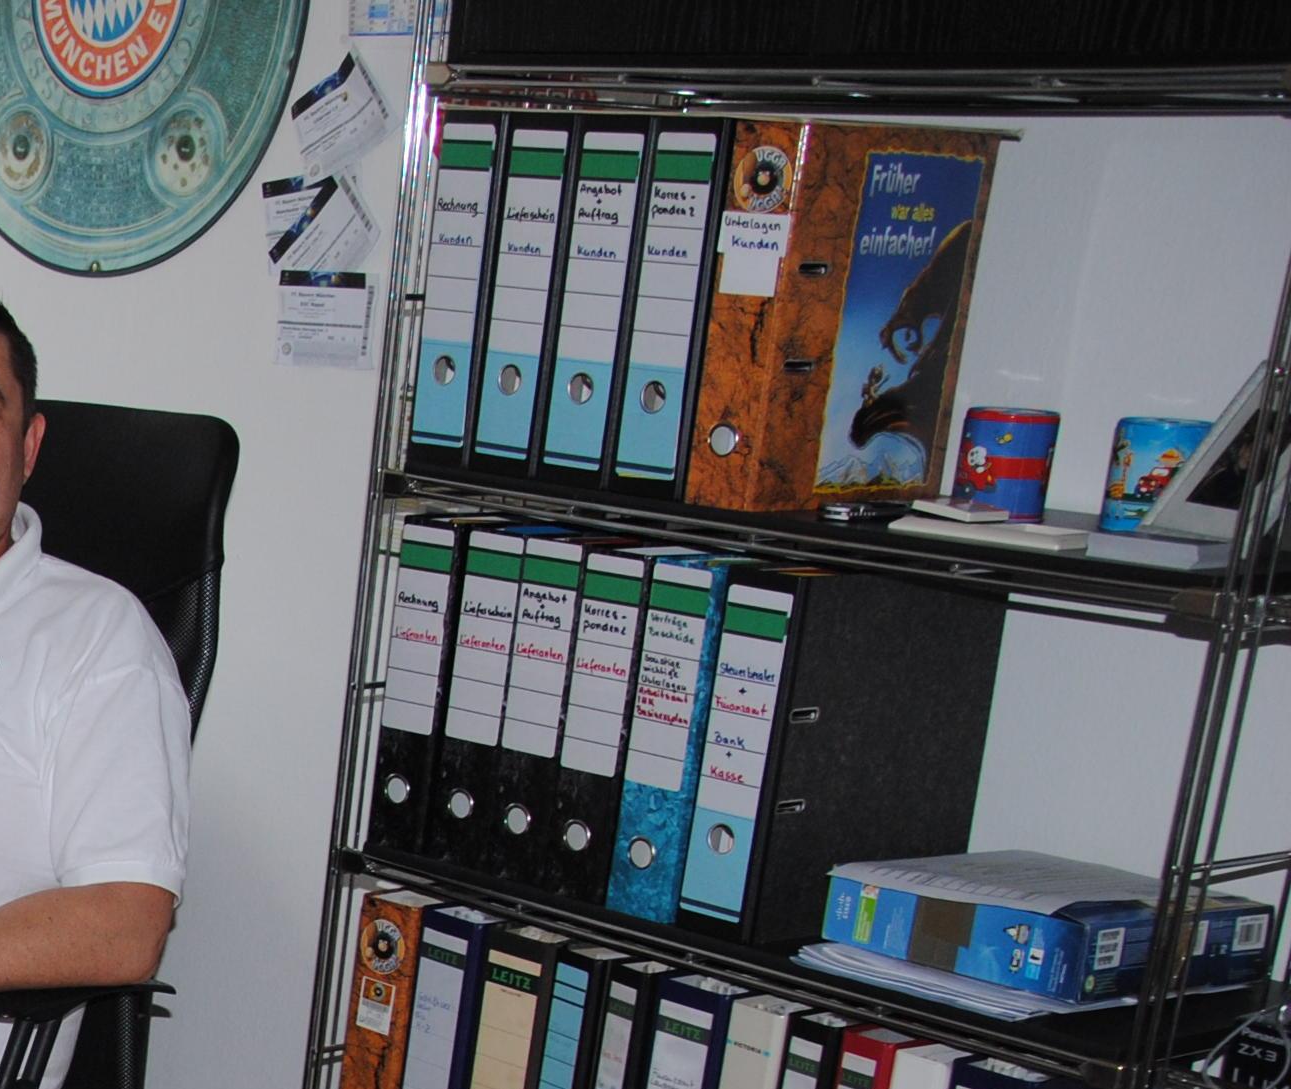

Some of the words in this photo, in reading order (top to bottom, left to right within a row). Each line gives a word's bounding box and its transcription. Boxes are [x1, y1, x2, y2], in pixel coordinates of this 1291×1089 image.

[45, 0, 149, 80] MÜNCHEN
[870, 163, 921, 196] Früher
[579, 184, 621, 197] Angebot
[437, 198, 478, 217] Rechnung
[578, 208, 619, 224] Auftrag
[891, 204, 909, 220] war
[912, 203, 935, 222] alles
[725, 215, 781, 234] Unterlagen
[439, 233, 473, 245] Kunden
[731, 235, 779, 250] Kunden
[860, 226, 936, 258] einfacher!
[507, 243, 541, 255] Kunden
[577, 245, 617, 259] Kunden
[647, 245, 687, 258] Kunden
[522, 611, 561, 628] Auftrag
[715, 731, 745, 749] Bank
[710, 765, 744, 783] Kasse
[491, 967, 532, 990] LEITZ
[664, 1018, 704, 1040] LEITZ
[1237, 1042, 1278, 1063] ZX3
